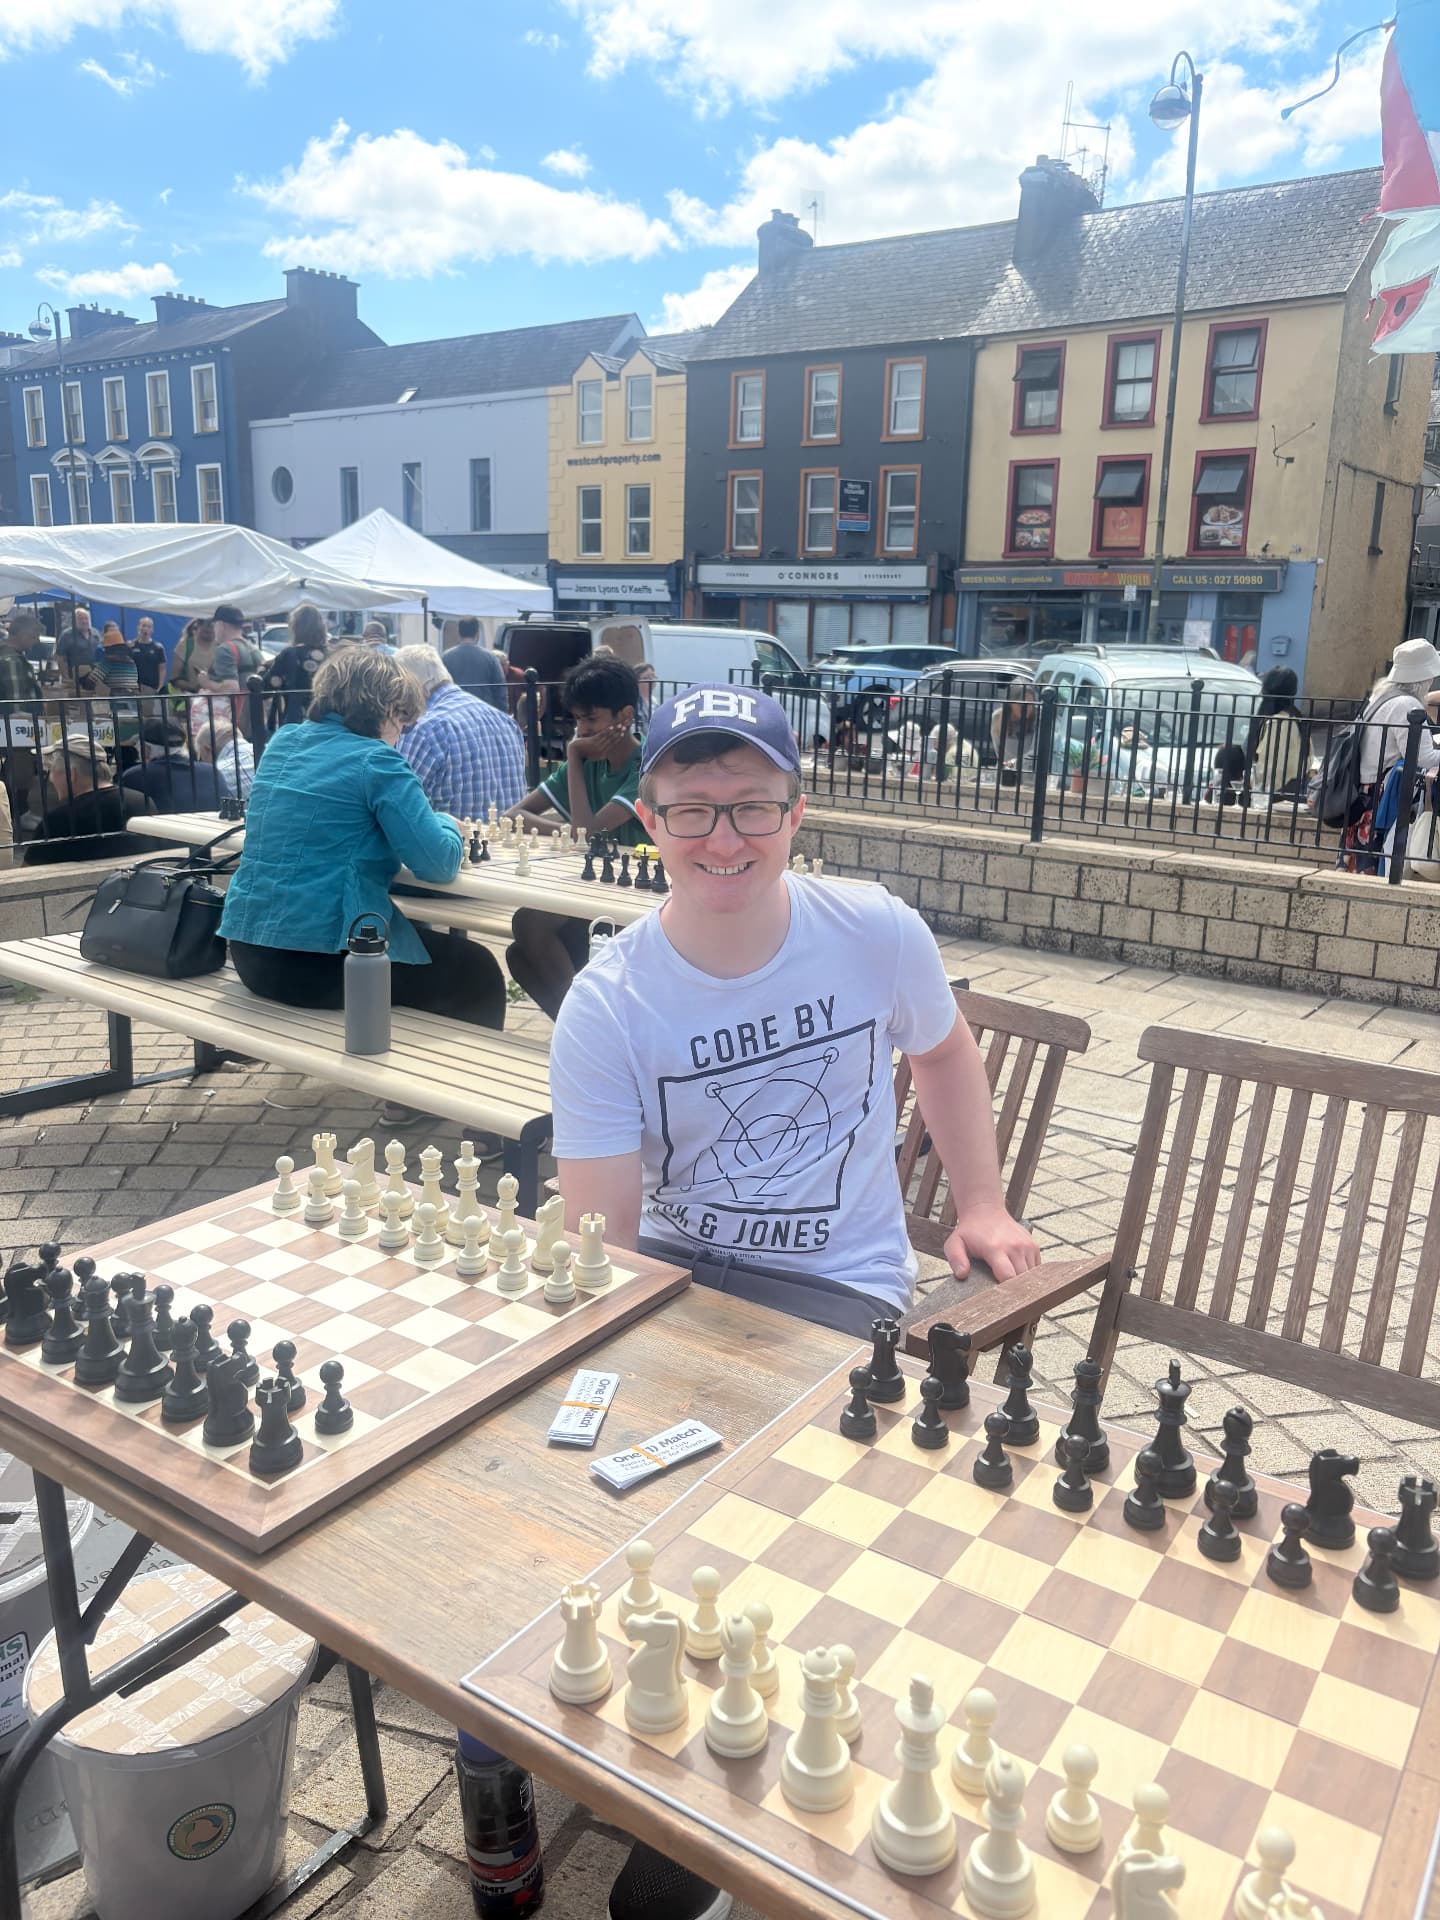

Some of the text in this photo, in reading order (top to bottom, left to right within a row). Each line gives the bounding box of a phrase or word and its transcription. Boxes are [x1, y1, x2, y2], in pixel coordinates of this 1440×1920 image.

[1172, 575, 1194, 585] CALL
[1214, 575, 1231, 585] 027
[671, 689, 757, 729] FBI
[690, 994, 836, 1069] CORE BY
[698, 1212, 718, 1239] &
[732, 1217, 830, 1249] JONES
[612, 1451, 643, 1463] One
[658, 1427, 702, 1448] Match
